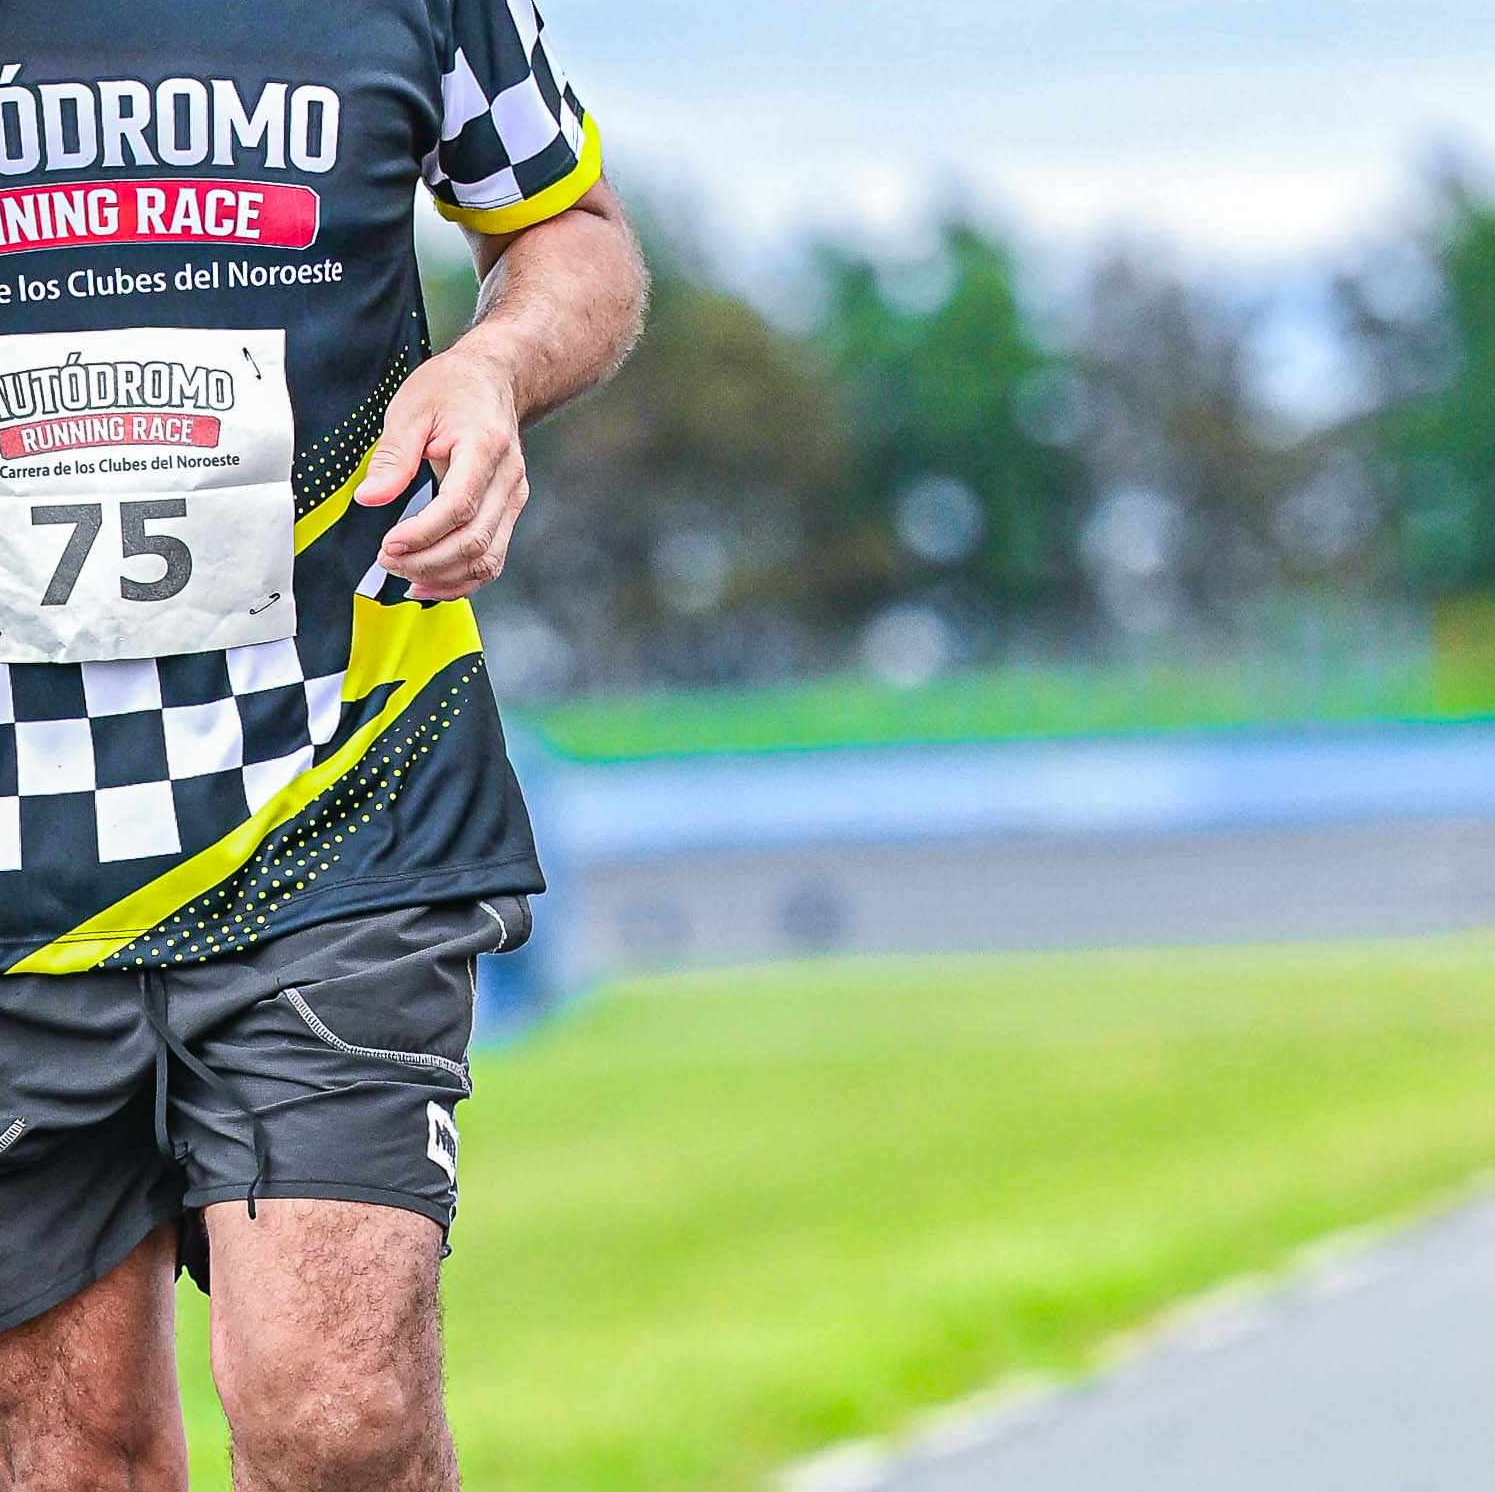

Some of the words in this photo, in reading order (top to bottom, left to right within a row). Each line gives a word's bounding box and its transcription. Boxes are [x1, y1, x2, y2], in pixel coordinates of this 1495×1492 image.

[135, 187, 264, 240] RACE
[18, 275, 61, 302] los
[67, 267, 167, 297] Clubes
[174, 261, 219, 291] del
[228, 258, 343, 288] Noroeste
[20, 417, 125, 454] RUNNING
[132, 415, 194, 444] RACE
[0, 463, 50, 479] Carrera
[53, 460, 72, 475] de
[75, 460, 95, 474] los
[99, 456, 147, 473] Clubes
[151, 454, 173, 470] del
[176, 453, 240, 469] Noroeste
[30, 497, 193, 607] 75
